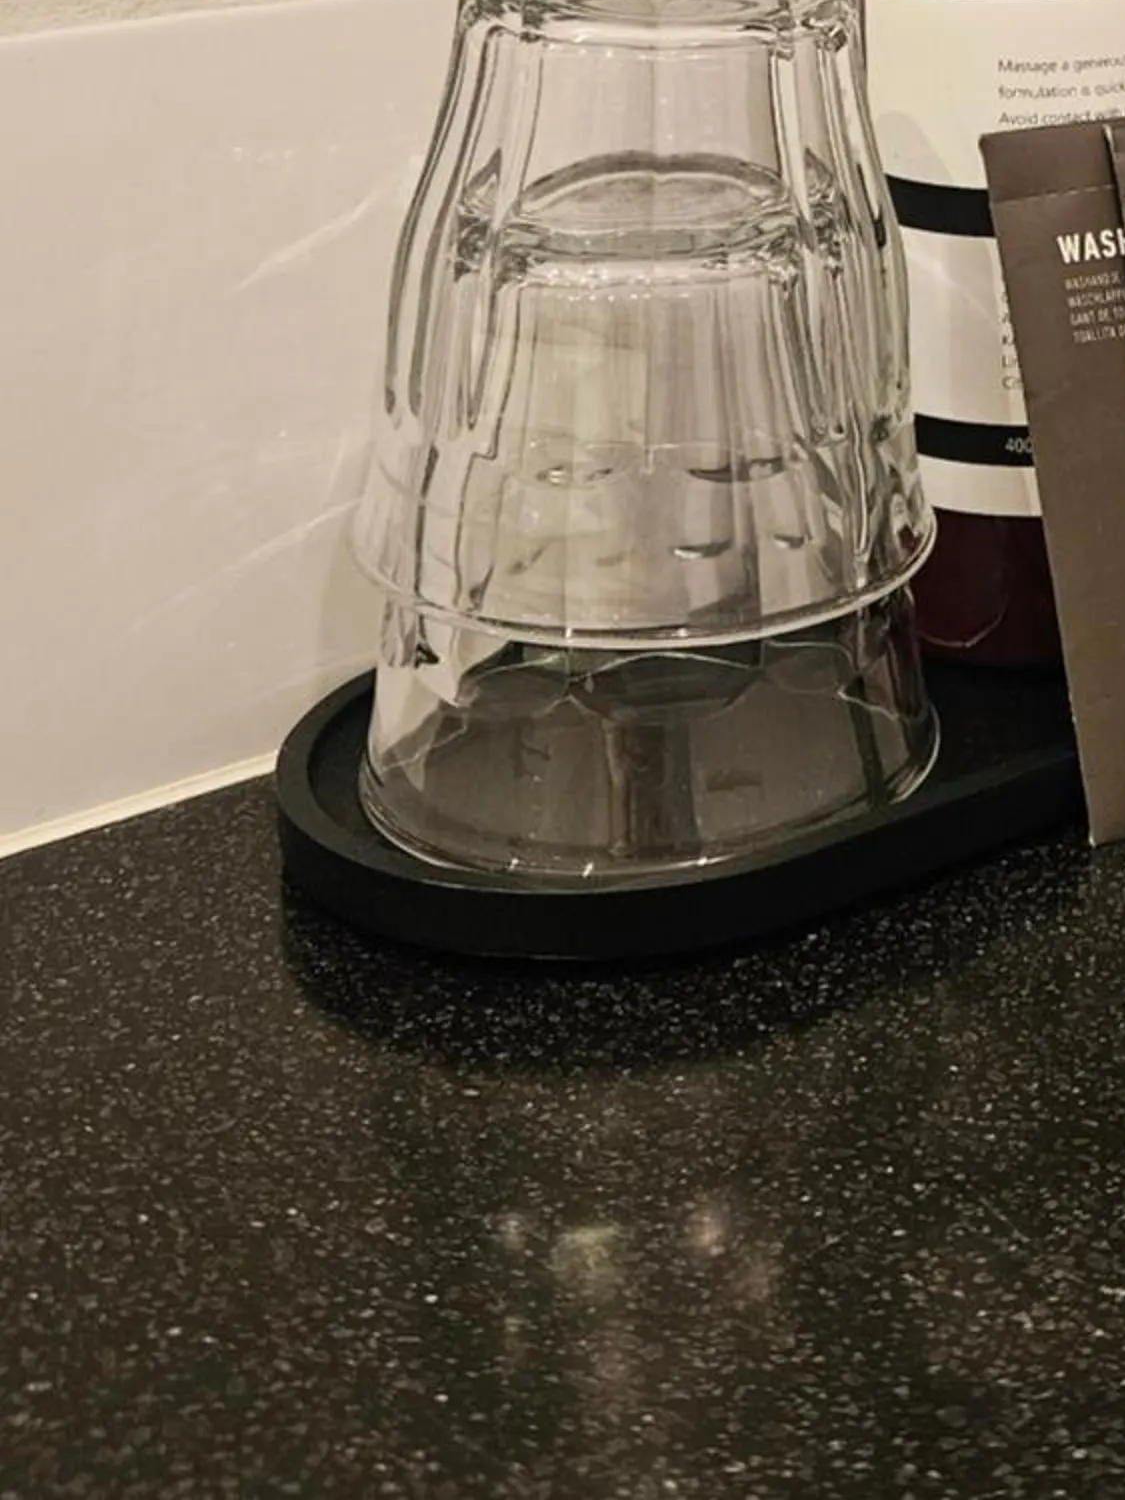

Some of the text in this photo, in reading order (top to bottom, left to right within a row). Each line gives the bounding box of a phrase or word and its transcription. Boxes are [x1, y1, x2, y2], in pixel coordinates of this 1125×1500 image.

[998, 59, 1057, 75] Massage
[1061, 61, 1069, 71] a
[998, 85, 1078, 100] formulation
[1000, 111, 1039, 126] Avoid
[1041, 109, 1091, 126] contact
